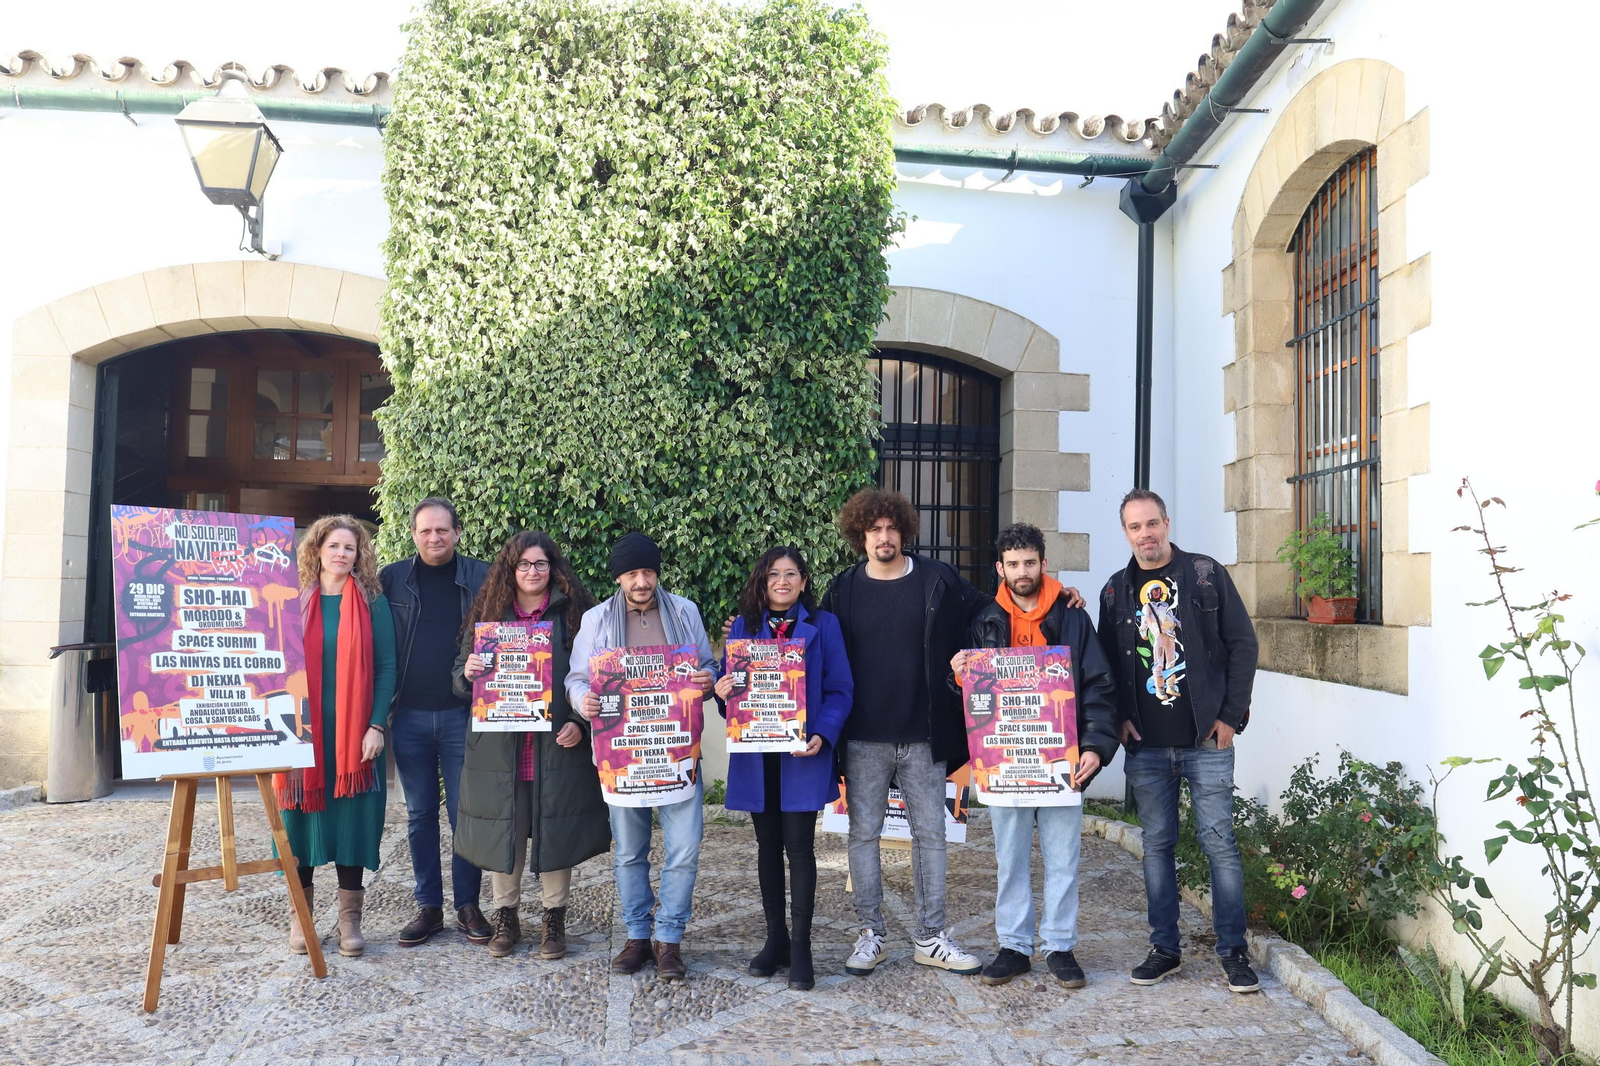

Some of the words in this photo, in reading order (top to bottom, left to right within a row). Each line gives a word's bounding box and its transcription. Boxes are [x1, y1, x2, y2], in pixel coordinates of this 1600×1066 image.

[174, 524, 188, 539] NO
[191, 525, 215, 540] SOLO
[217, 527, 237, 541] POR
[175, 540, 238, 562] NAVIDAD
[129, 583, 144, 595] 29
[146, 583, 165, 595] DIC
[184, 589, 247, 606] SHO-HAI
[184, 609, 232, 622] MORODO
[235, 612, 241, 620] &
[225, 620, 243, 628] LIONS
[178, 635, 214, 649] SPACE
[216, 636, 257, 649] SURIMI
[156, 655, 177, 668] LAS
[180, 656, 221, 669] NINYAS
[223, 656, 242, 669] DEL
[244, 657, 282, 669] CORRO
[625, 657, 634, 665] NO
[636, 656, 650, 665] SOLO
[652, 655, 664, 664] POR
[996, 657, 1005, 666] NO
[1006, 657, 1020, 666] SOLO
[1022, 656, 1034, 665] POR
[191, 675, 204, 687] DJ
[207, 674, 241, 686] NEXXA
[209, 689, 234, 700] VILLA
[235, 689, 246, 700] 18
[599, 695, 608, 703] 29
[609, 695, 620, 703] DIC
[631, 695, 669, 707] SHO-HAI
[1002, 696, 1041, 706] SHO-HAI
[227, 707, 255, 715] VANDALS
[631, 708, 660, 717] MORODO
[1002, 708, 1032, 717] MORODO
[206, 716, 211, 724] V
[212, 715, 237, 723] SANTOS
[243, 714, 261, 722] CAOS
[628, 725, 649, 733] SPACE
[651, 724, 675, 732] SURIMI
[1022, 724, 1047, 732] SURIMI
[162, 738, 187, 747] ENTRADA
[187, 737, 213, 745] GRATUITA
[214, 736, 231, 744] HASTA
[231, 735, 261, 743] COMPLETAR
[614, 739, 627, 747] LAS
[628, 738, 653, 746] NINYAS
[654, 737, 666, 745] DEL
[667, 735, 690, 744] CORRO
[986, 737, 999, 745] LAS
[1000, 737, 1024, 745] NINYAS
[1026, 737, 1038, 745] DEL
[1039, 737, 1063, 745] CORRO
[635, 750, 642, 758] DJ
[644, 748, 665, 757] NEXXA
[1006, 749, 1014, 757] DJ
[1015, 748, 1037, 756] NEXXA
